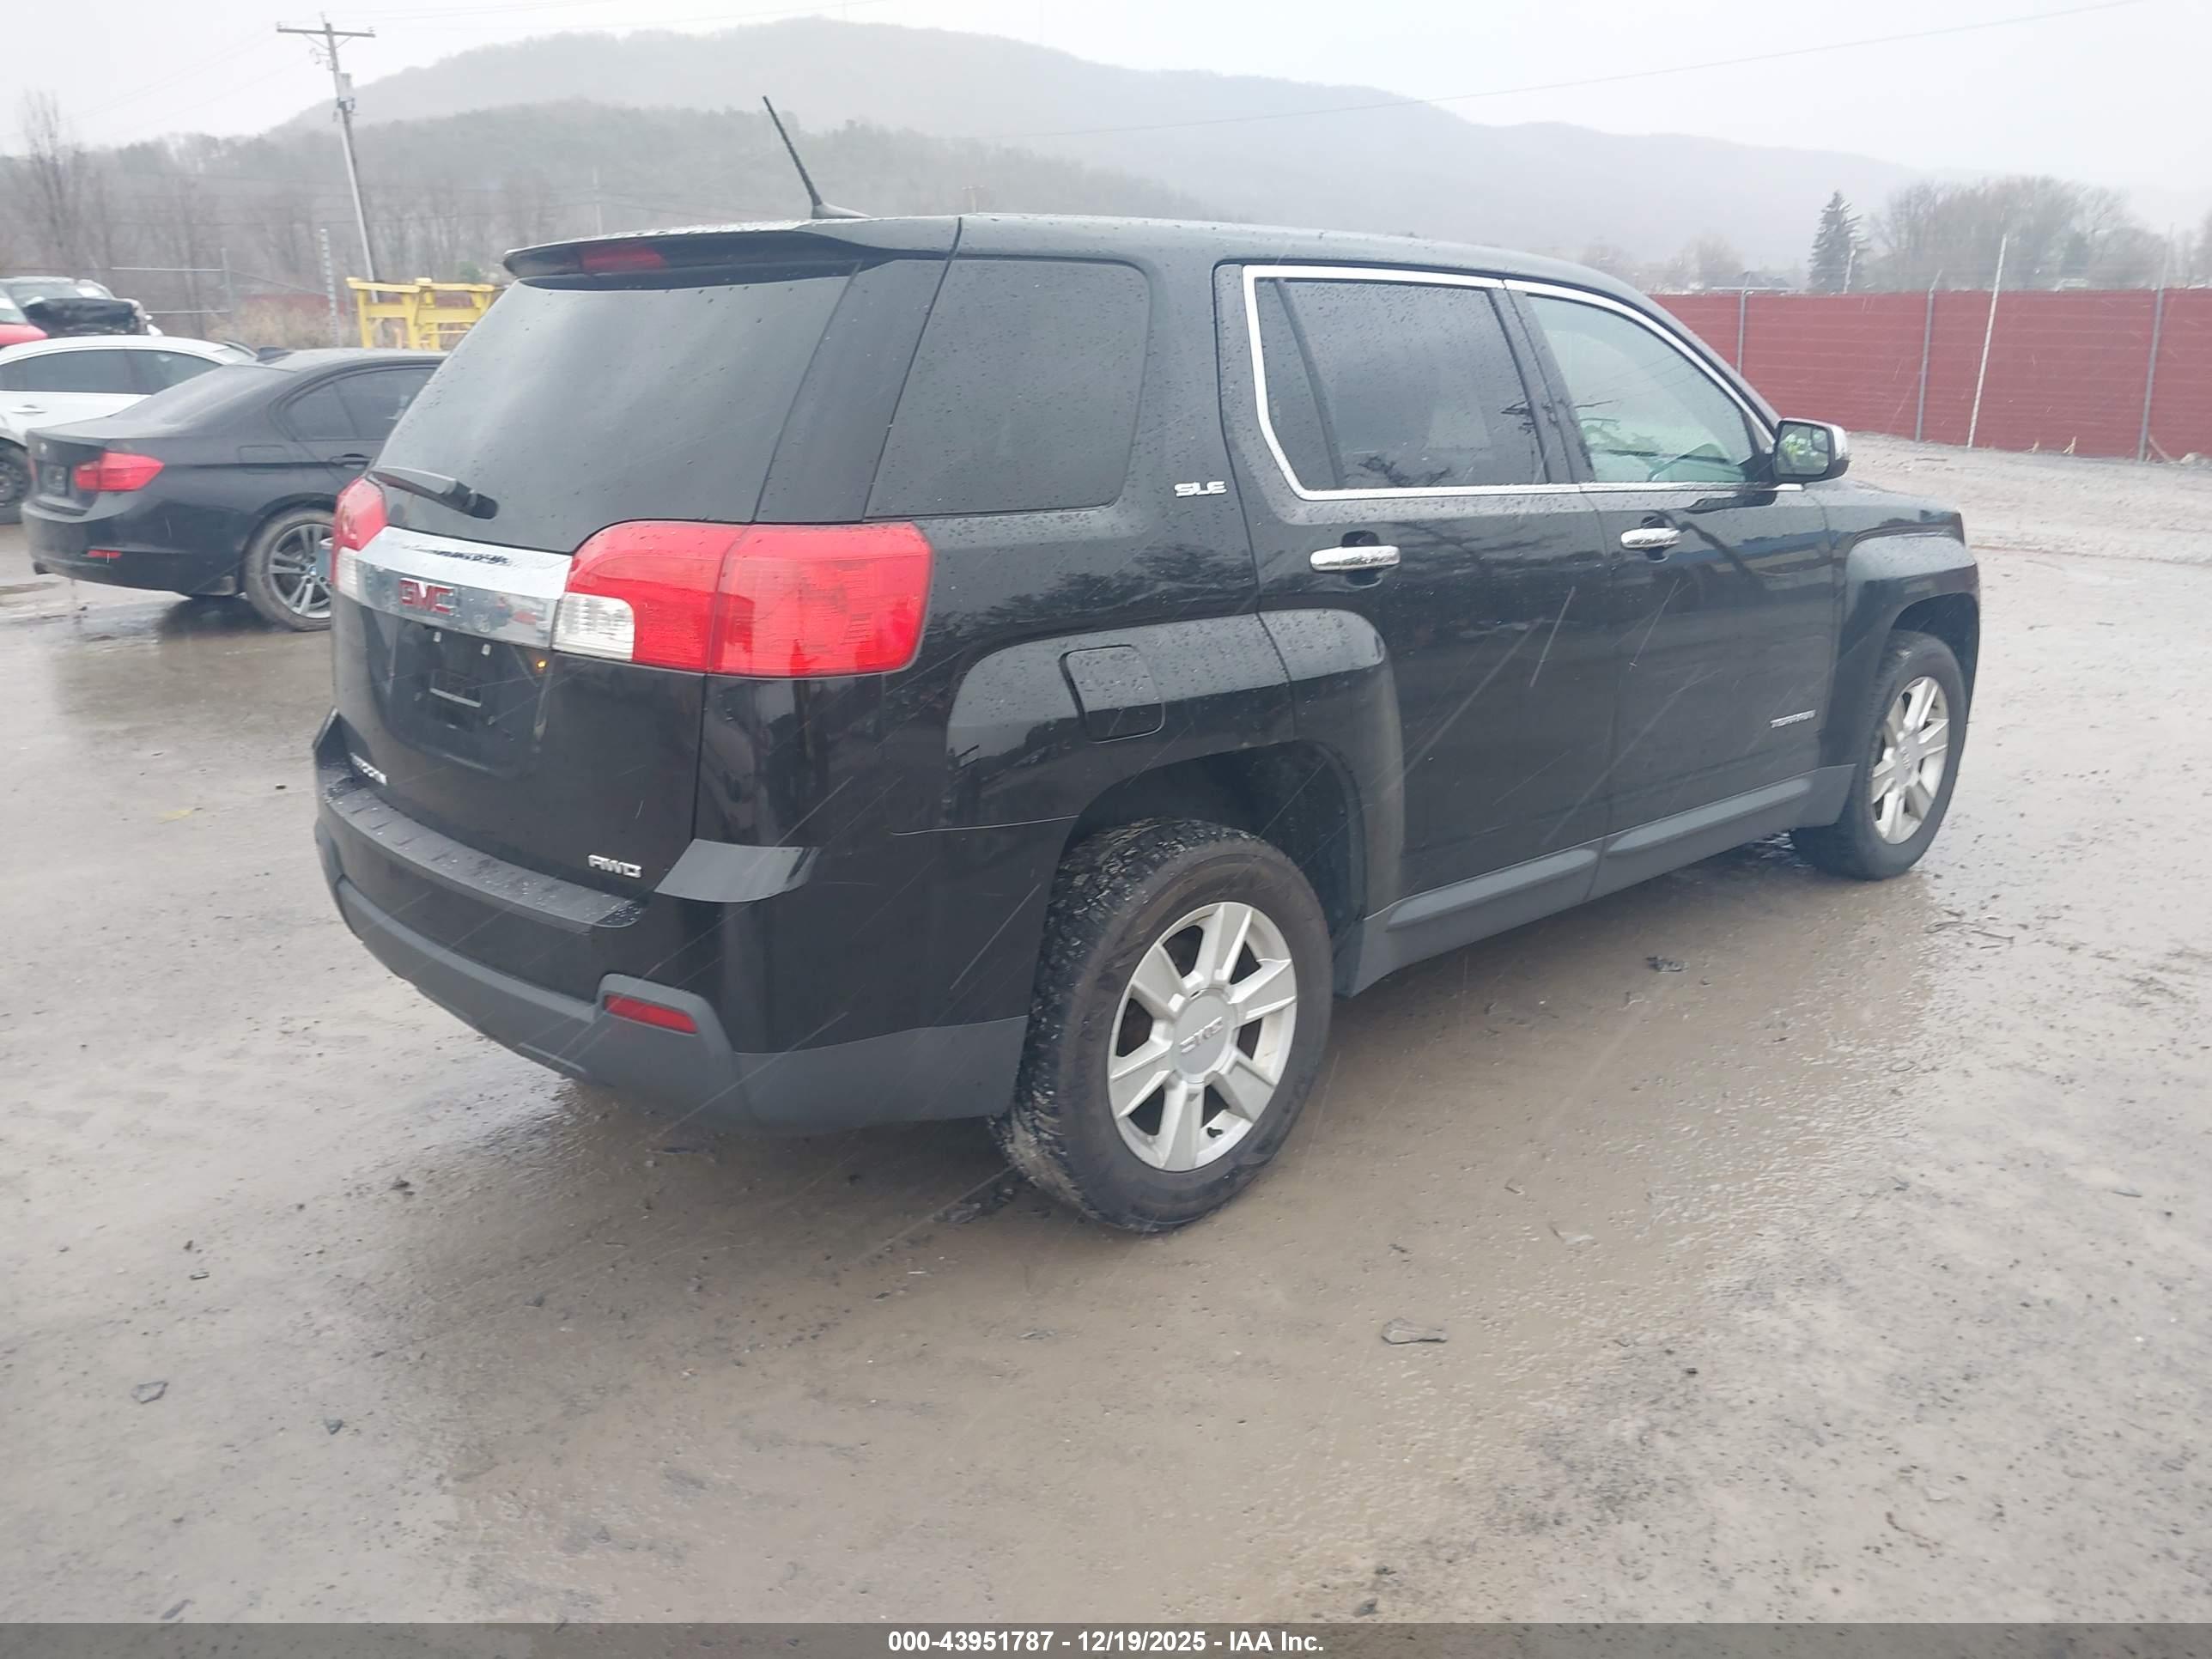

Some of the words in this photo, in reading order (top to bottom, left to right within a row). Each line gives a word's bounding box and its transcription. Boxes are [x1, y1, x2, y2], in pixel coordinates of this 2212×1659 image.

[1174, 481, 1227, 497] SLE
[398, 577, 458, 615] GMC
[587, 854, 641, 878] AWD
